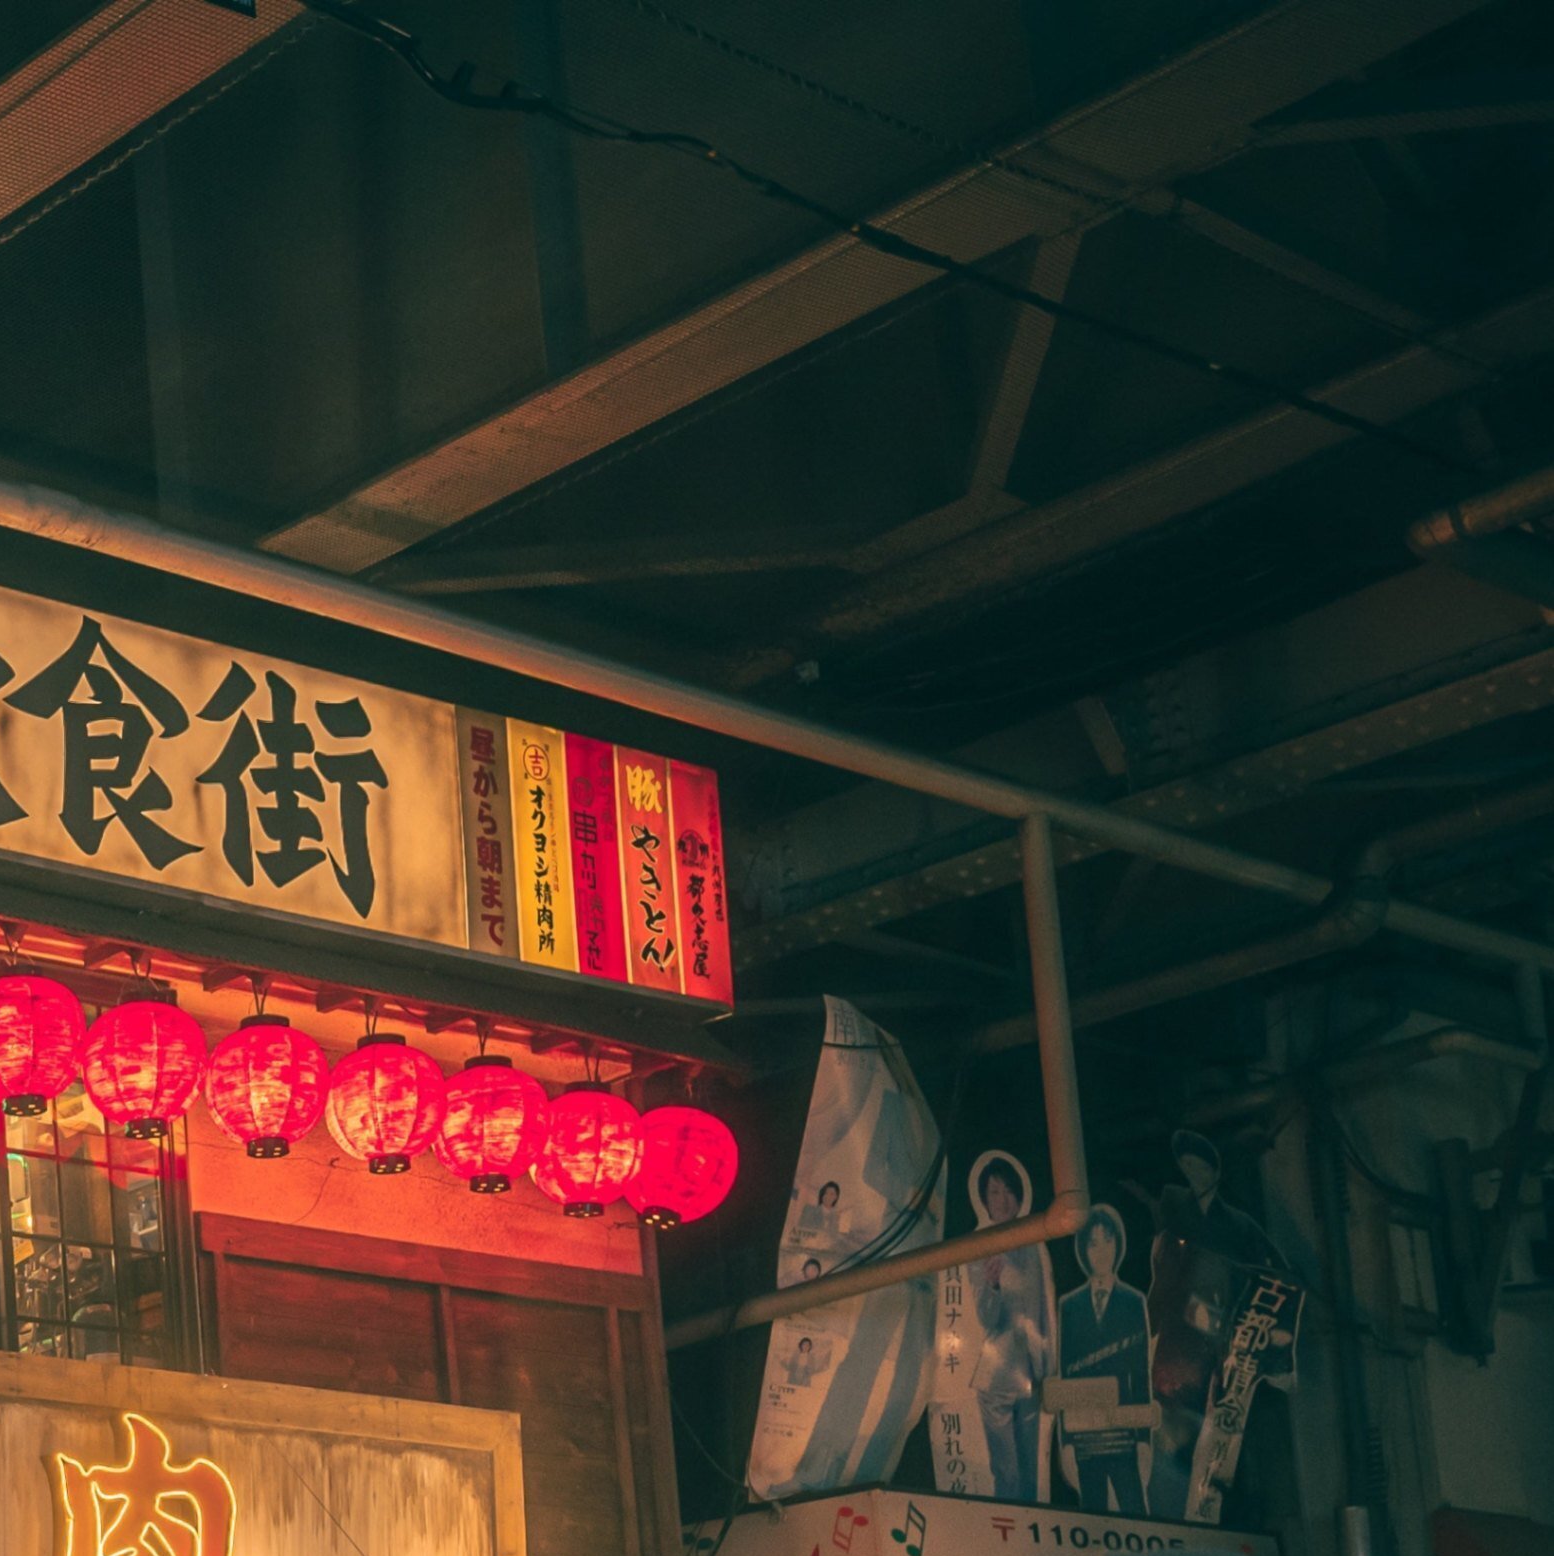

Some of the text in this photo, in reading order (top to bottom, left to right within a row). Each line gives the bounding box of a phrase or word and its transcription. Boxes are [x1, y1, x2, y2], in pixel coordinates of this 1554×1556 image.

[470, 725, 506, 948] 昼から朝まで
[625, 765, 662, 814] 豚
